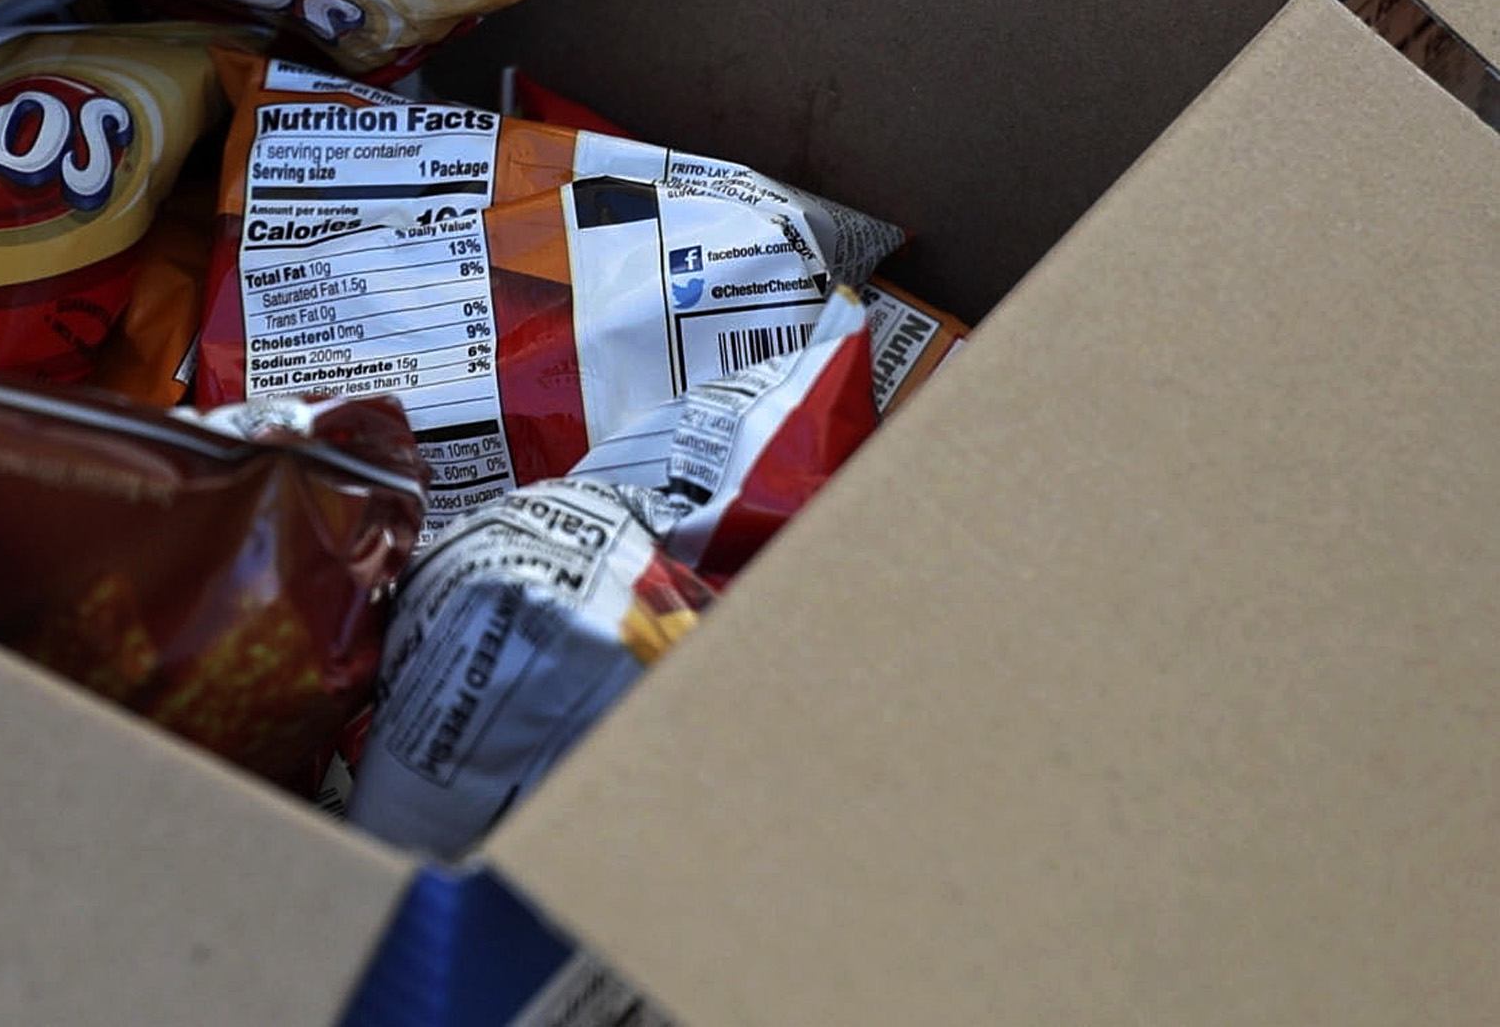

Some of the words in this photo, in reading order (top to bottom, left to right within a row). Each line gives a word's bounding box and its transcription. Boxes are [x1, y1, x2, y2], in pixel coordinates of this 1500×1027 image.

[260, 108, 398, 134] Nutrition
[406, 107, 495, 132] Facts
[254, 144, 262, 159] 1
[267, 145, 323, 165] serving
[325, 146, 350, 161] per
[352, 143, 423, 160] container
[252, 162, 306, 184] Serving
[308, 162, 337, 181] size
[418, 162, 427, 178] 1
[430, 160, 489, 178] Package
[249, 205, 294, 217] Amount
[295, 206, 316, 218] per
[317, 205, 359, 218] serving
[246, 219, 363, 243] Calories
[245, 272, 282, 290] Total
[283, 265, 308, 282] Fat
[309, 261, 332, 280] 10g
[448, 238, 482, 257] 13%
[262, 285, 319, 309] Saturated
[320, 279, 341, 298] Fat
[341, 278, 368, 296] 1.5g
[459, 261, 485, 278] 8%
[250, 326, 336, 354] Cholesterol
[337, 322, 365, 340] 0mg
[463, 300, 489, 318] 0%
[264, 313, 298, 331] Trans
[299, 307, 320, 325] Fat
[320, 305, 337, 323] 0g
[250, 354, 307, 372] Sodium
[308, 347, 353, 365] 200mg
[466, 322, 492, 340] 9%
[250, 373, 290, 390] Total
[291, 359, 394, 384] Carbohydrate
[396, 356, 419, 372] 15g
[467, 343, 493, 358] 6%
[346, 380, 372, 395] less
[373, 375, 401, 392] than
[404, 372, 420, 388] 1g
[467, 358, 492, 374] 3%
[447, 442, 480, 459] 10mg
[482, 437, 502, 452] 0%
[443, 464, 478, 481] 60mg
[486, 457, 507, 473] 0%
[463, 487, 505, 507] sugars
